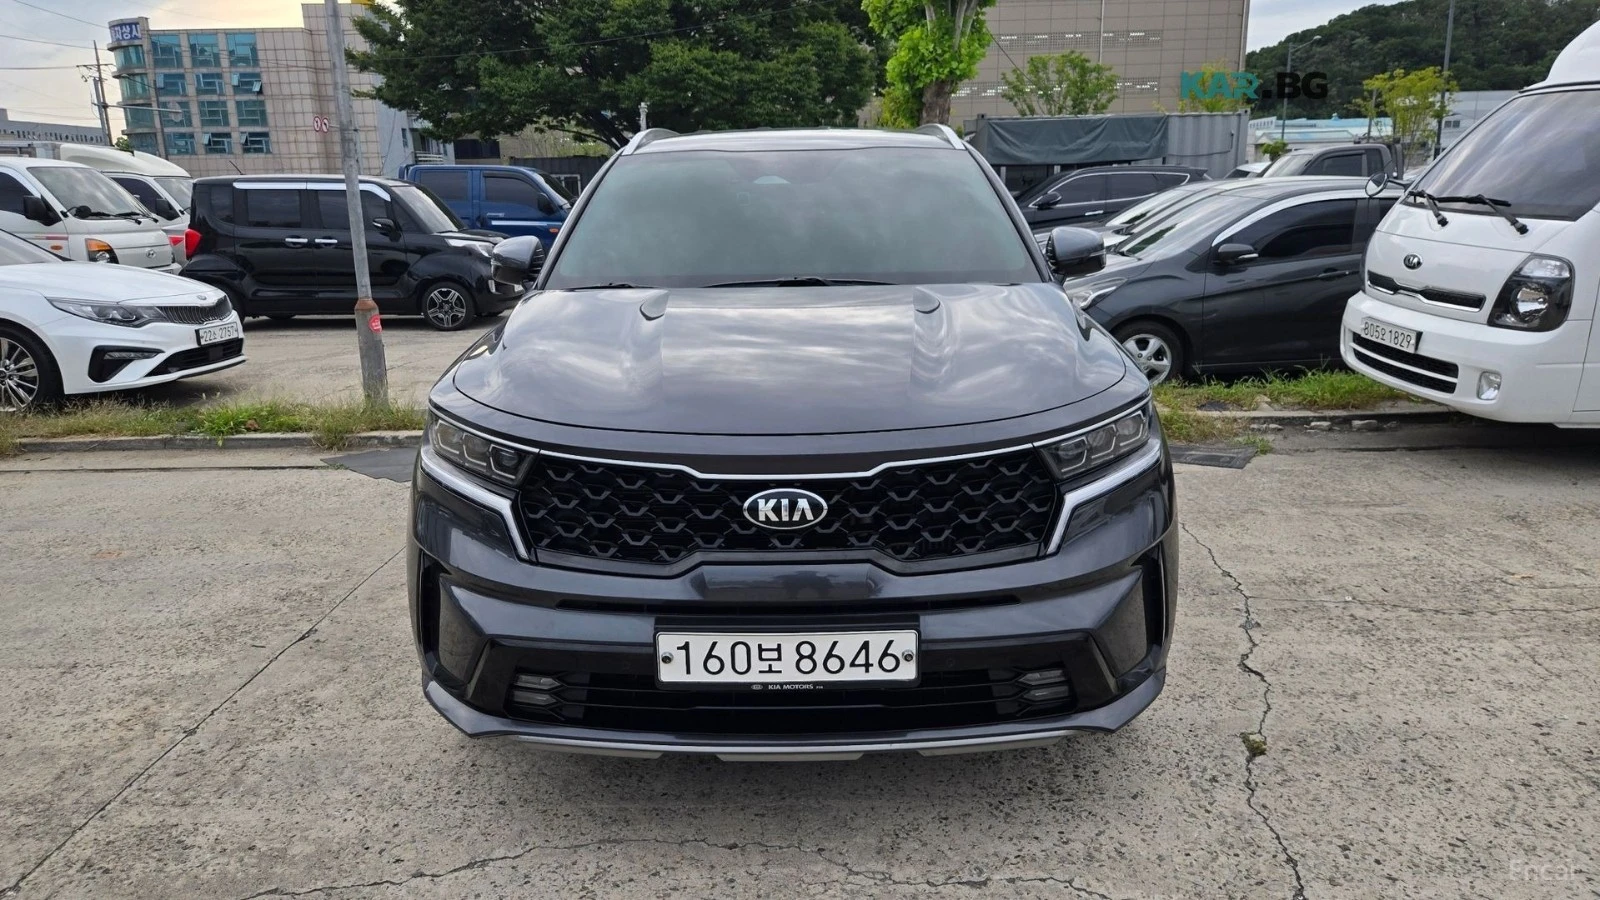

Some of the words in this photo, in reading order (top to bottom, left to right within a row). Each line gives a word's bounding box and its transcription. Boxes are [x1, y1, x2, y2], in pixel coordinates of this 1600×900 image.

[1389, 329, 1412, 349] 1829
[757, 498, 815, 522] KIA
[676, 640, 783, 675] 160보
[795, 639, 901, 675] 8646
